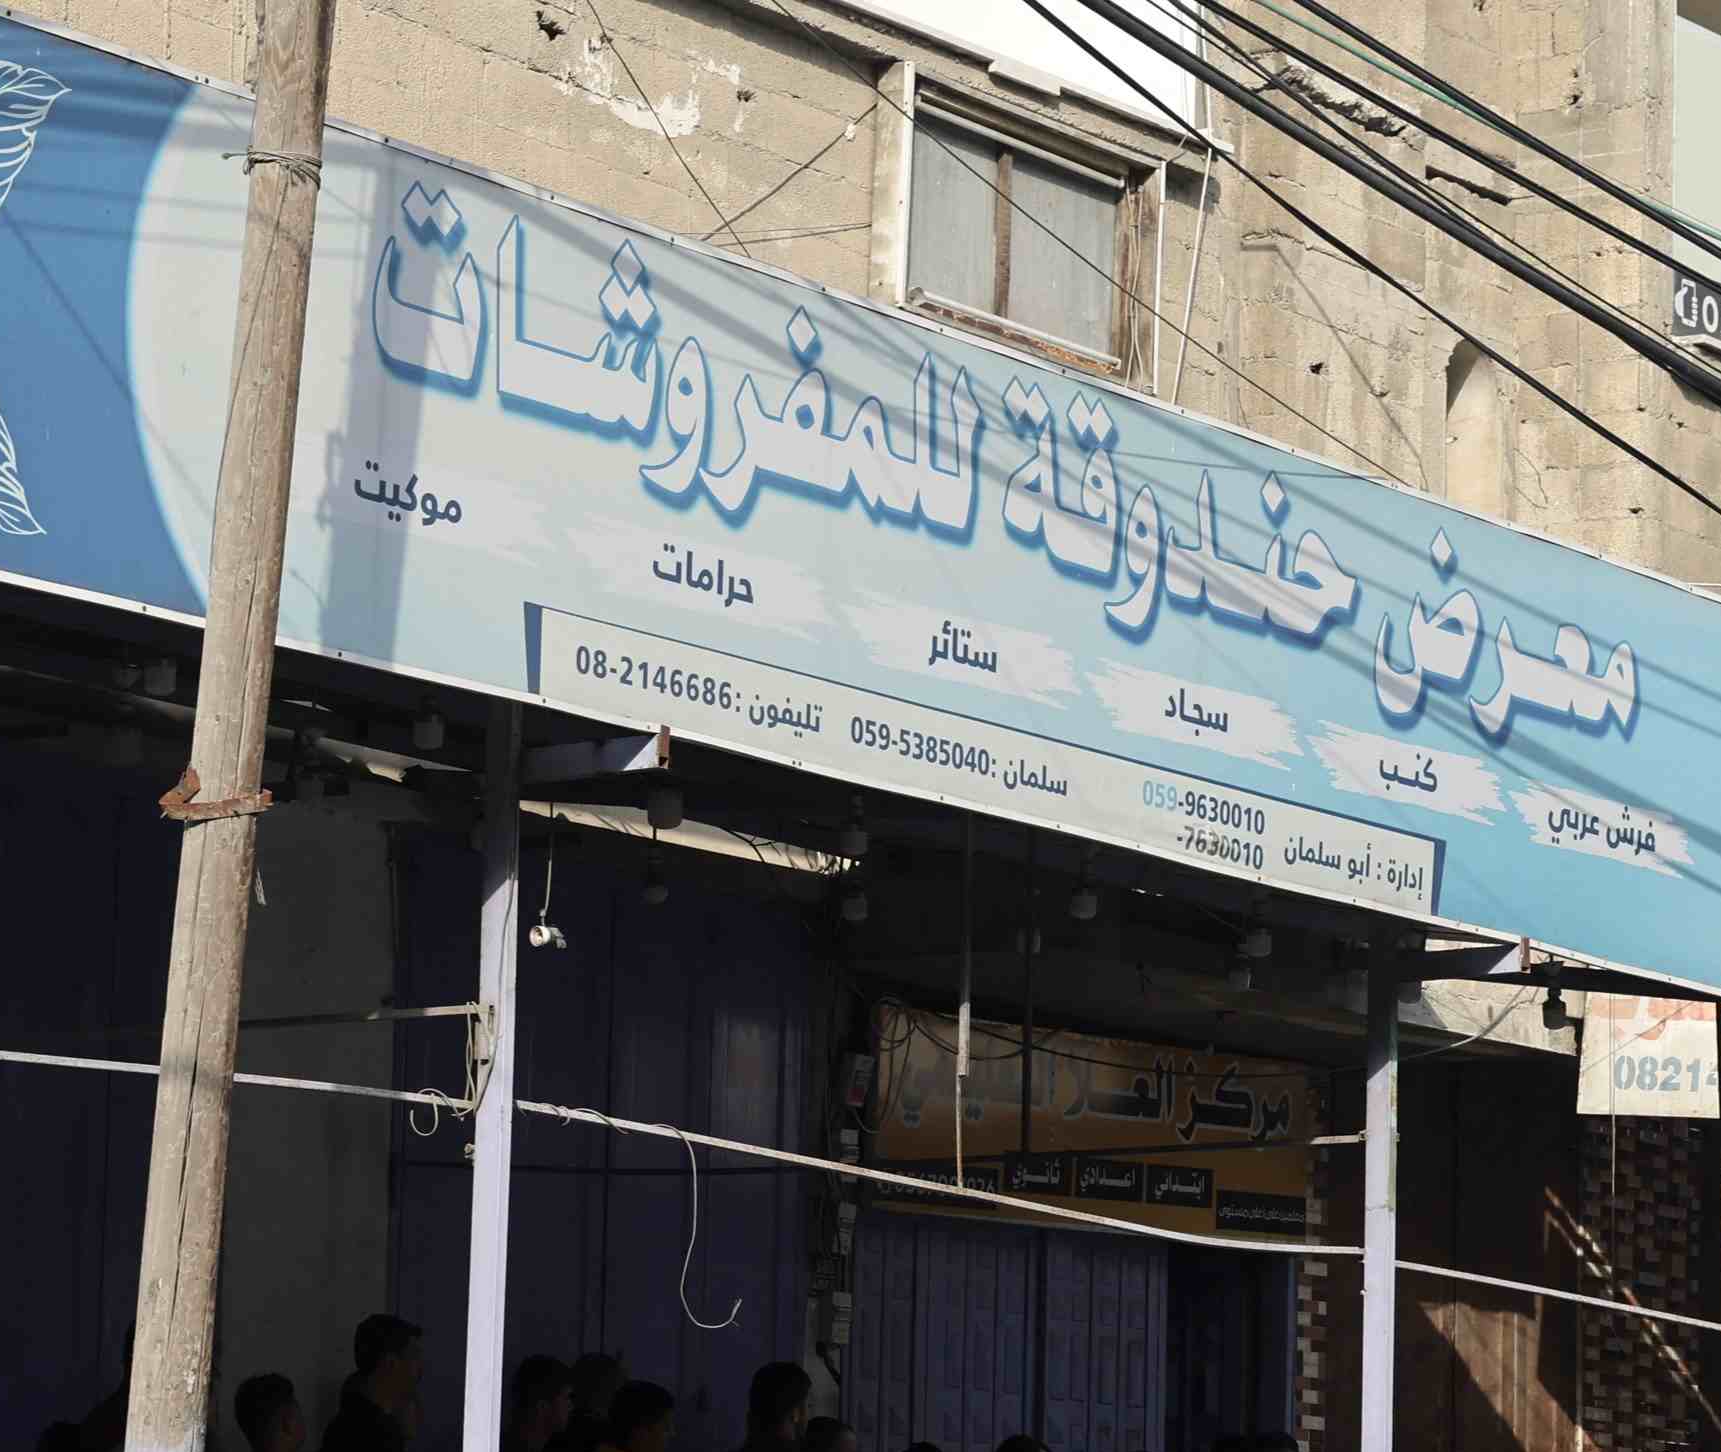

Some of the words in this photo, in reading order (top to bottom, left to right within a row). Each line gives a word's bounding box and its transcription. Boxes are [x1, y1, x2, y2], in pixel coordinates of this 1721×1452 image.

[371, 179, 986, 547] للمفروشات
[353, 460, 462, 526] موكيت
[652, 542, 754, 608] حرامات
[928, 619, 999, 674] ستائر
[1373, 526, 1640, 742] معرض
[748, 703, 823, 740] تليفون
[1163, 687, 1230, 738] سجاد
[1002, 755, 1068, 798] سلمان
[1142, 779, 1266, 836] 059-9630010
[1547, 806, 1600, 844] عربي
[1605, 805, 1657, 856] فرش
[1283, 835, 1342, 873] سلمان
[1387, 855, 1424, 901] إدارة
